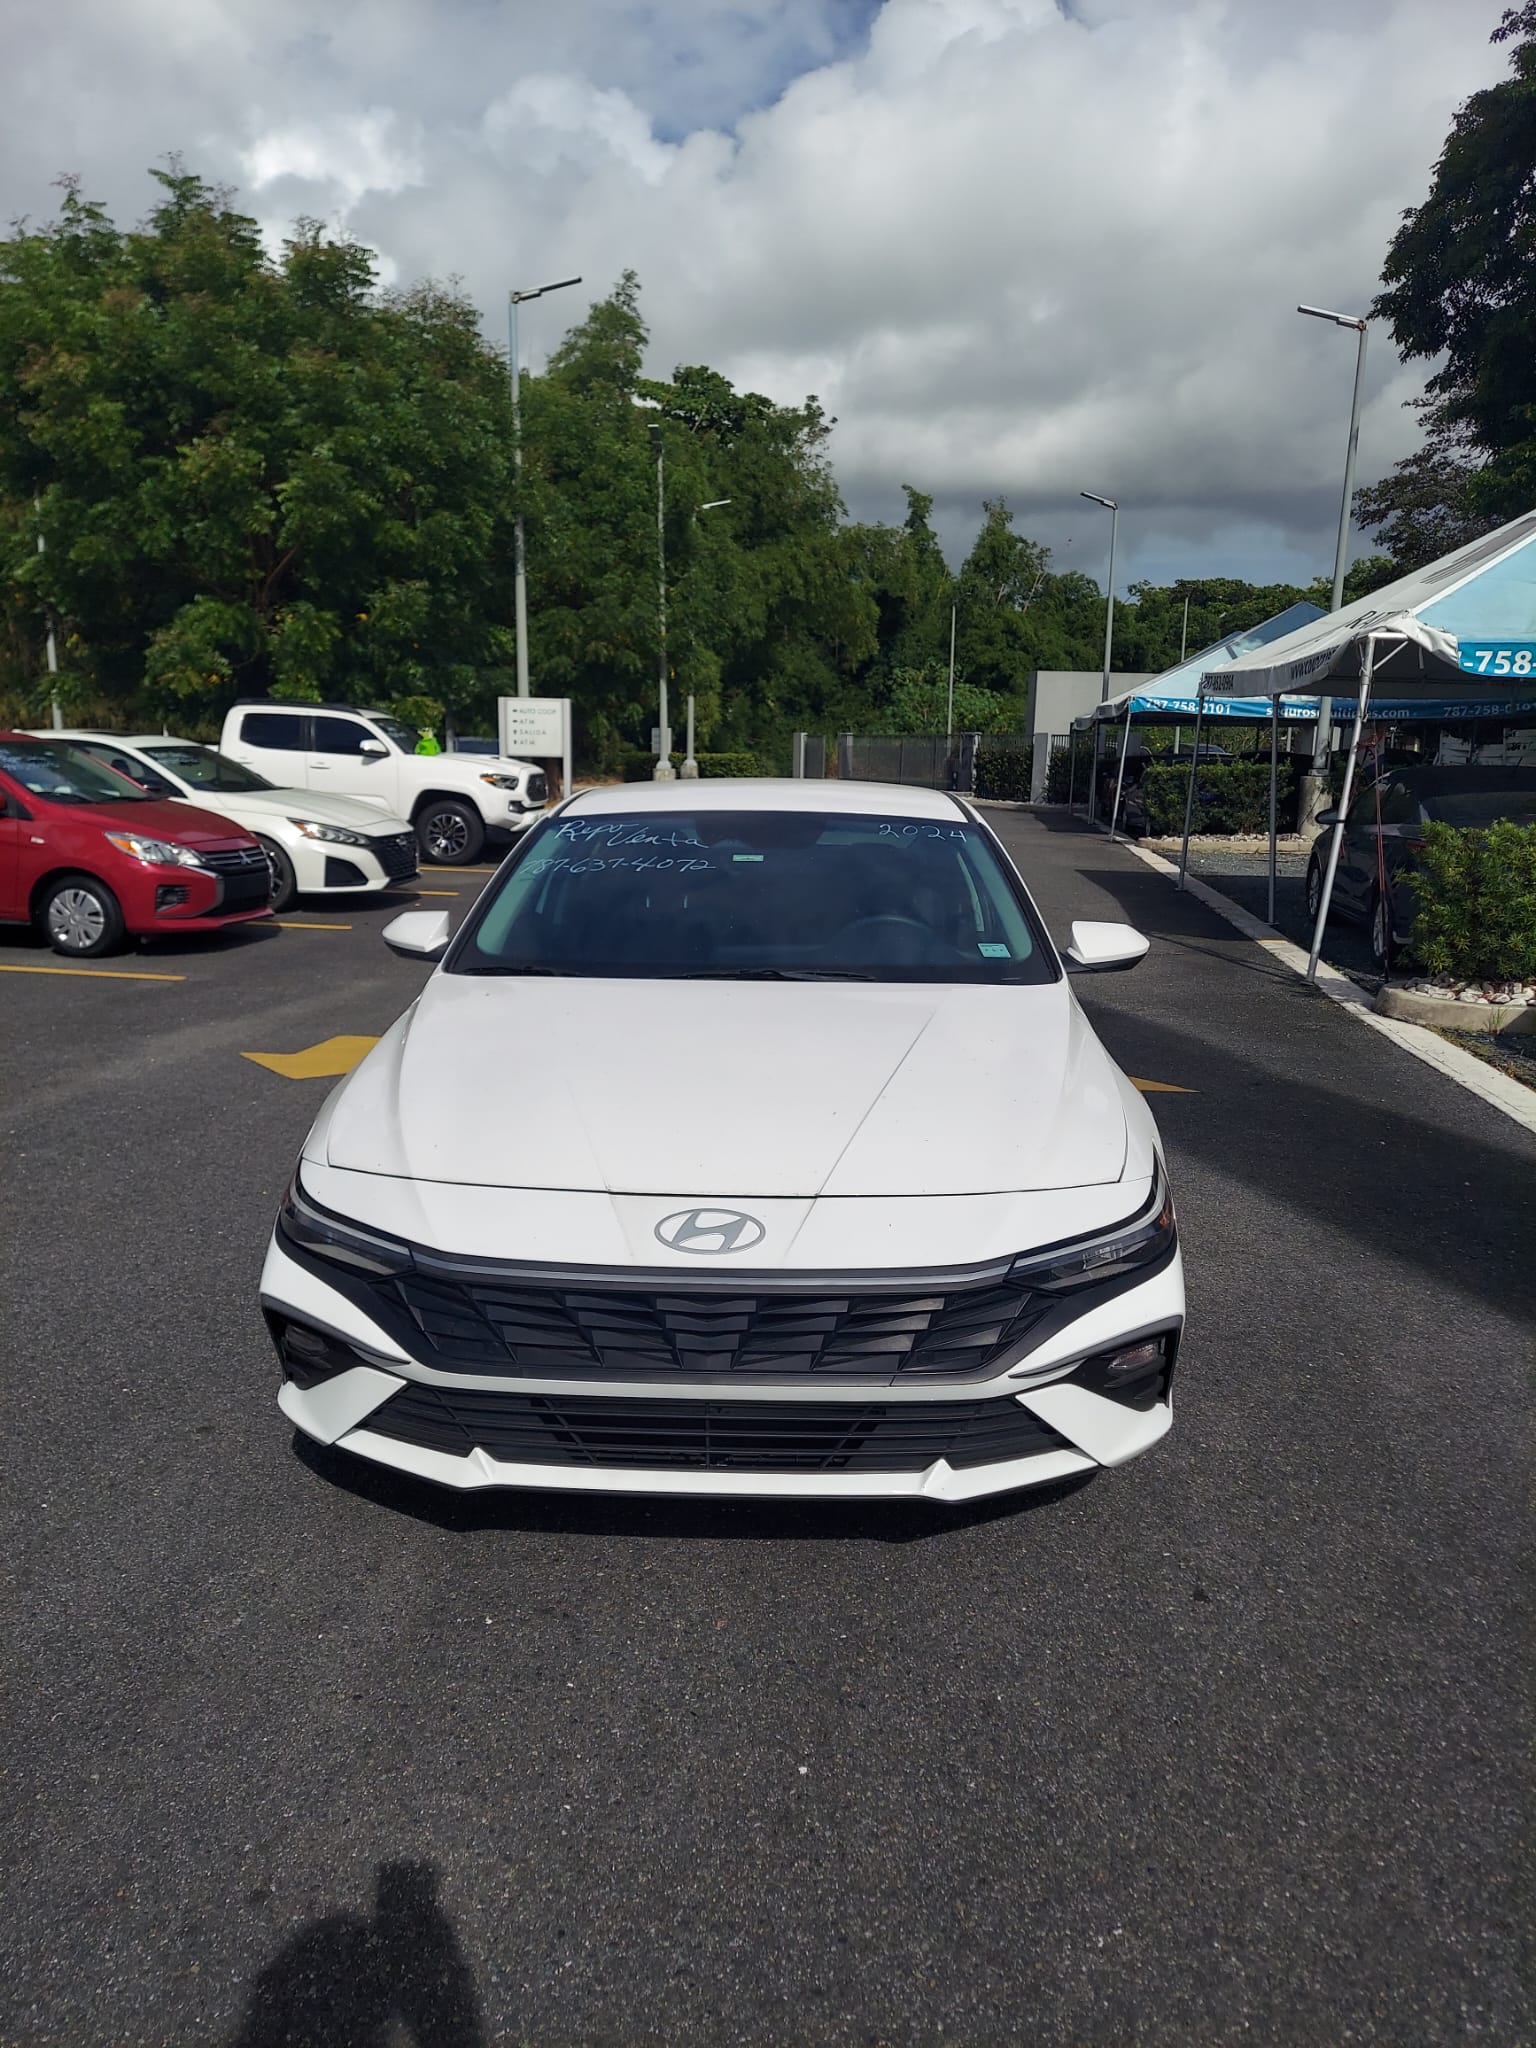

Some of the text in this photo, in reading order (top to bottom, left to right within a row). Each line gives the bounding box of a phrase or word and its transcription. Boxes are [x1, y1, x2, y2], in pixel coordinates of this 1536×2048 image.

[519, 728, 547, 736] SALIDA
[607, 826, 710, 849] Venta
[879, 823, 967, 843] 2024
[518, 855, 717, 874] 787-637-4072
